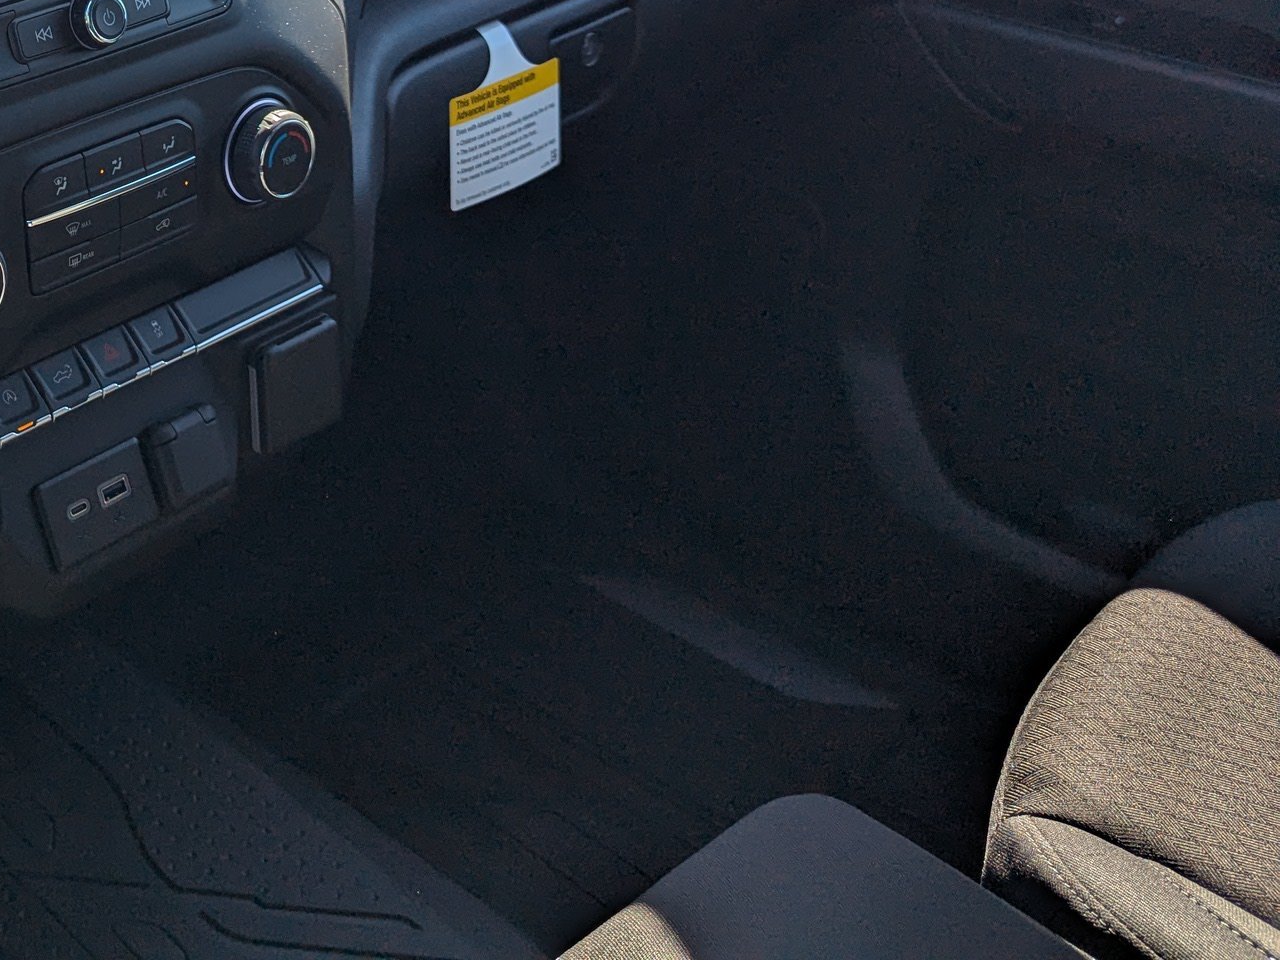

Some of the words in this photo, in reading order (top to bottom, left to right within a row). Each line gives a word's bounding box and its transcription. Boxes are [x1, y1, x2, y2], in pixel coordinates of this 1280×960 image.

[456, 99, 470, 109] This
[470, 90, 491, 104] Vehicle
[492, 88, 497, 96] is
[498, 78, 523, 94] Equipped
[524, 72, 536, 83] with
[456, 103, 486, 120] Advanced
[486, 100, 495, 109] Air
[281, 153, 297, 166] TEMP
[156, 187, 168, 200] A/C
[82, 250, 95, 260] REAR
